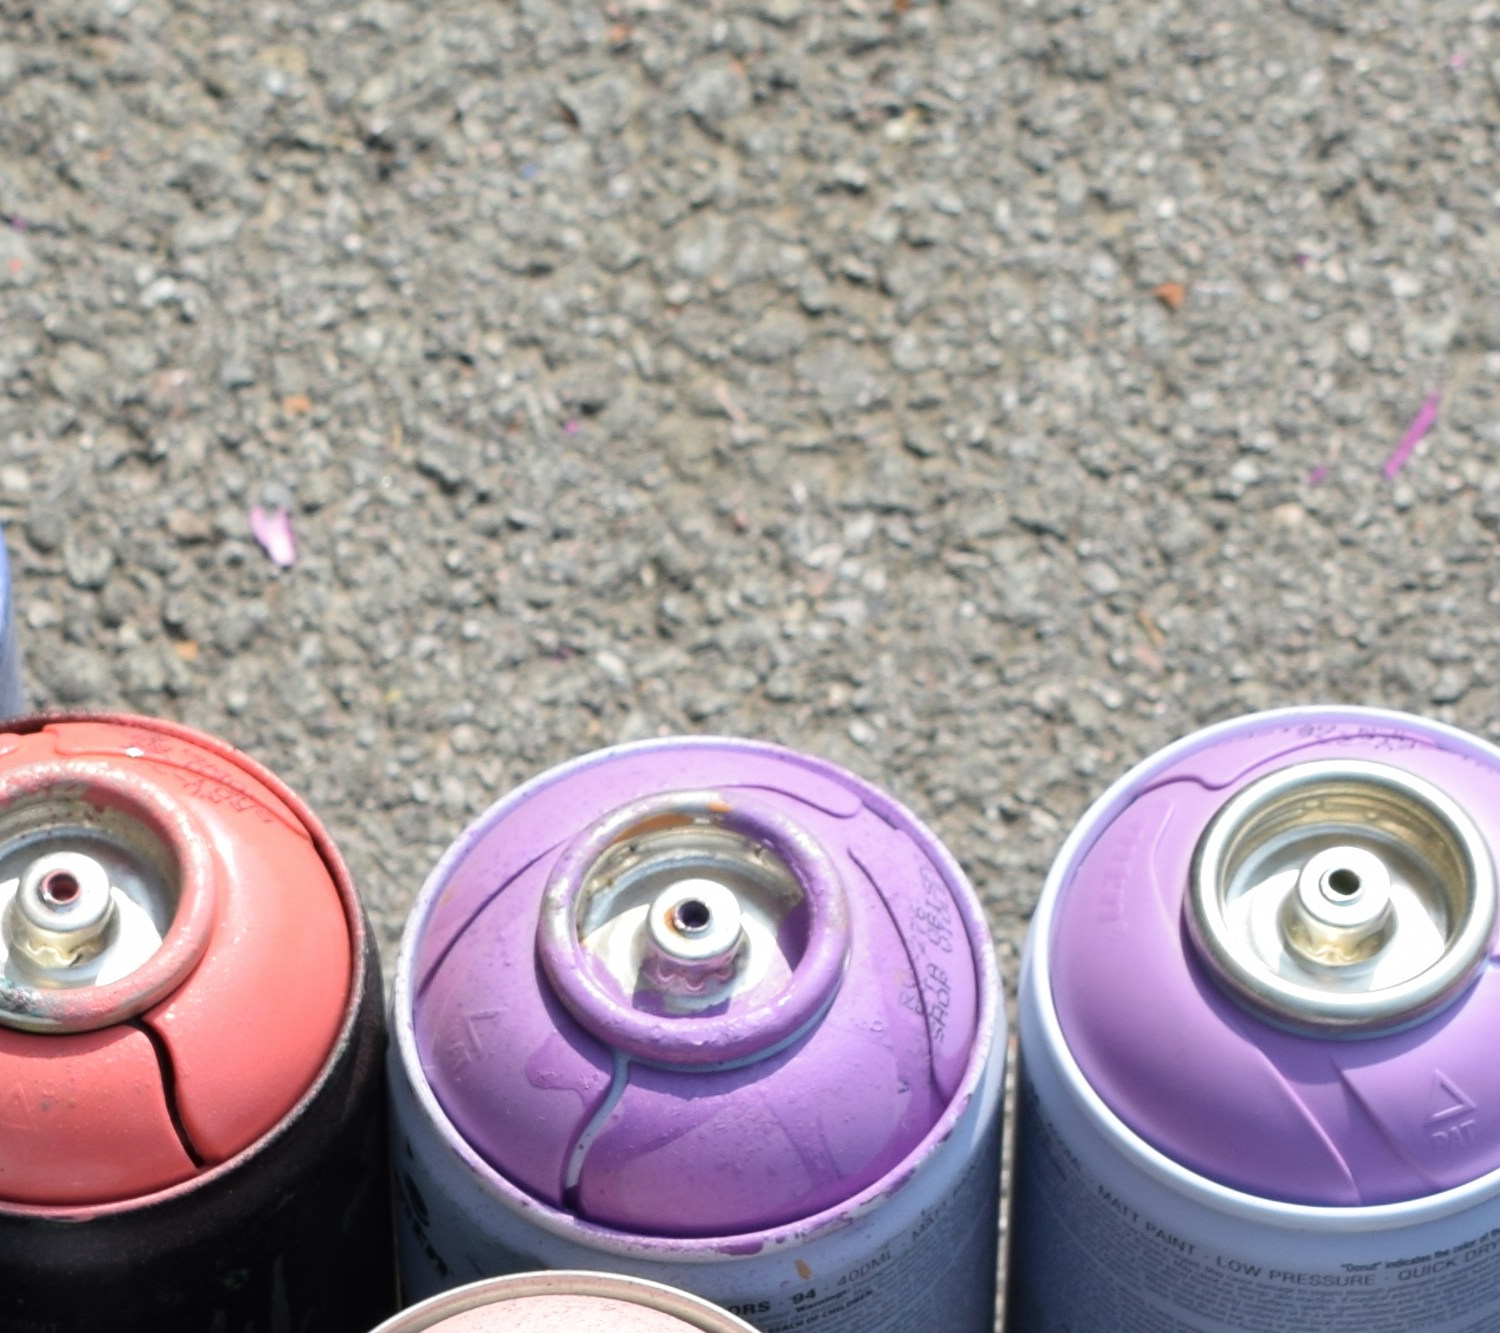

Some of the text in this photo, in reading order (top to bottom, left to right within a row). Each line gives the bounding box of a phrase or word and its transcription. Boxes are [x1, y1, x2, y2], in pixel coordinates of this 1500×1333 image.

[1145, 1219, 1197, 1256] PAINT
[1216, 1254, 1261, 1278] LOW
[1268, 1269, 1375, 1287] PRESSURE
[1398, 1257, 1458, 1281] QUICK
